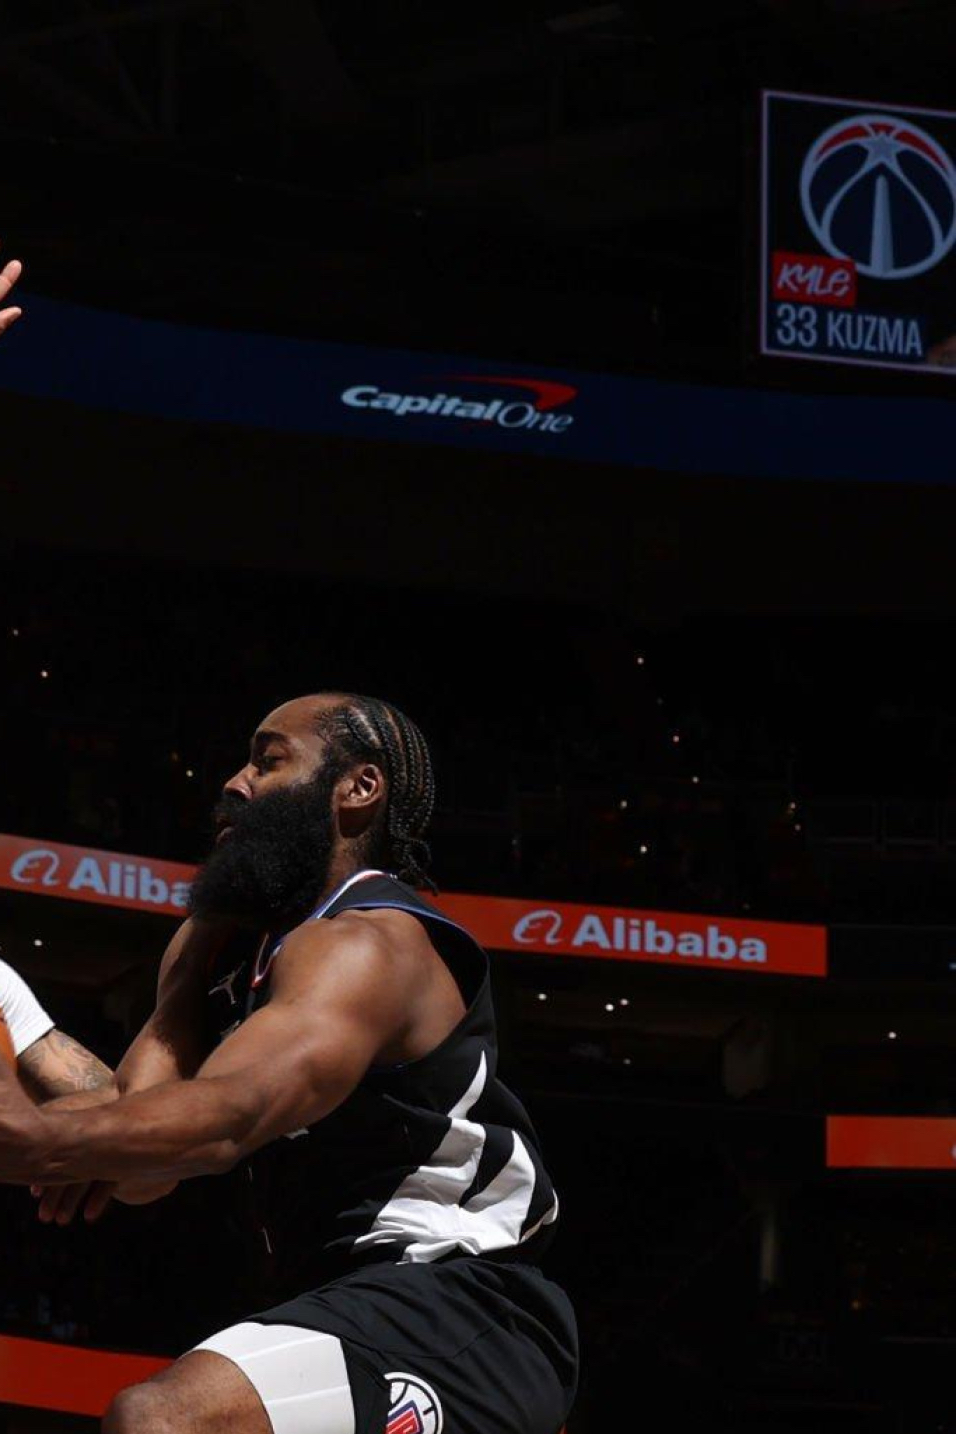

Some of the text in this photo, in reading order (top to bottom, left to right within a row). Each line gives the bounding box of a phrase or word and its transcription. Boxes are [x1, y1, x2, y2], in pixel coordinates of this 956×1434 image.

[776, 303, 924, 358] 33 KUZMA
[68, 856, 193, 908] Aliba
[571, 913, 768, 963] Alibaba
